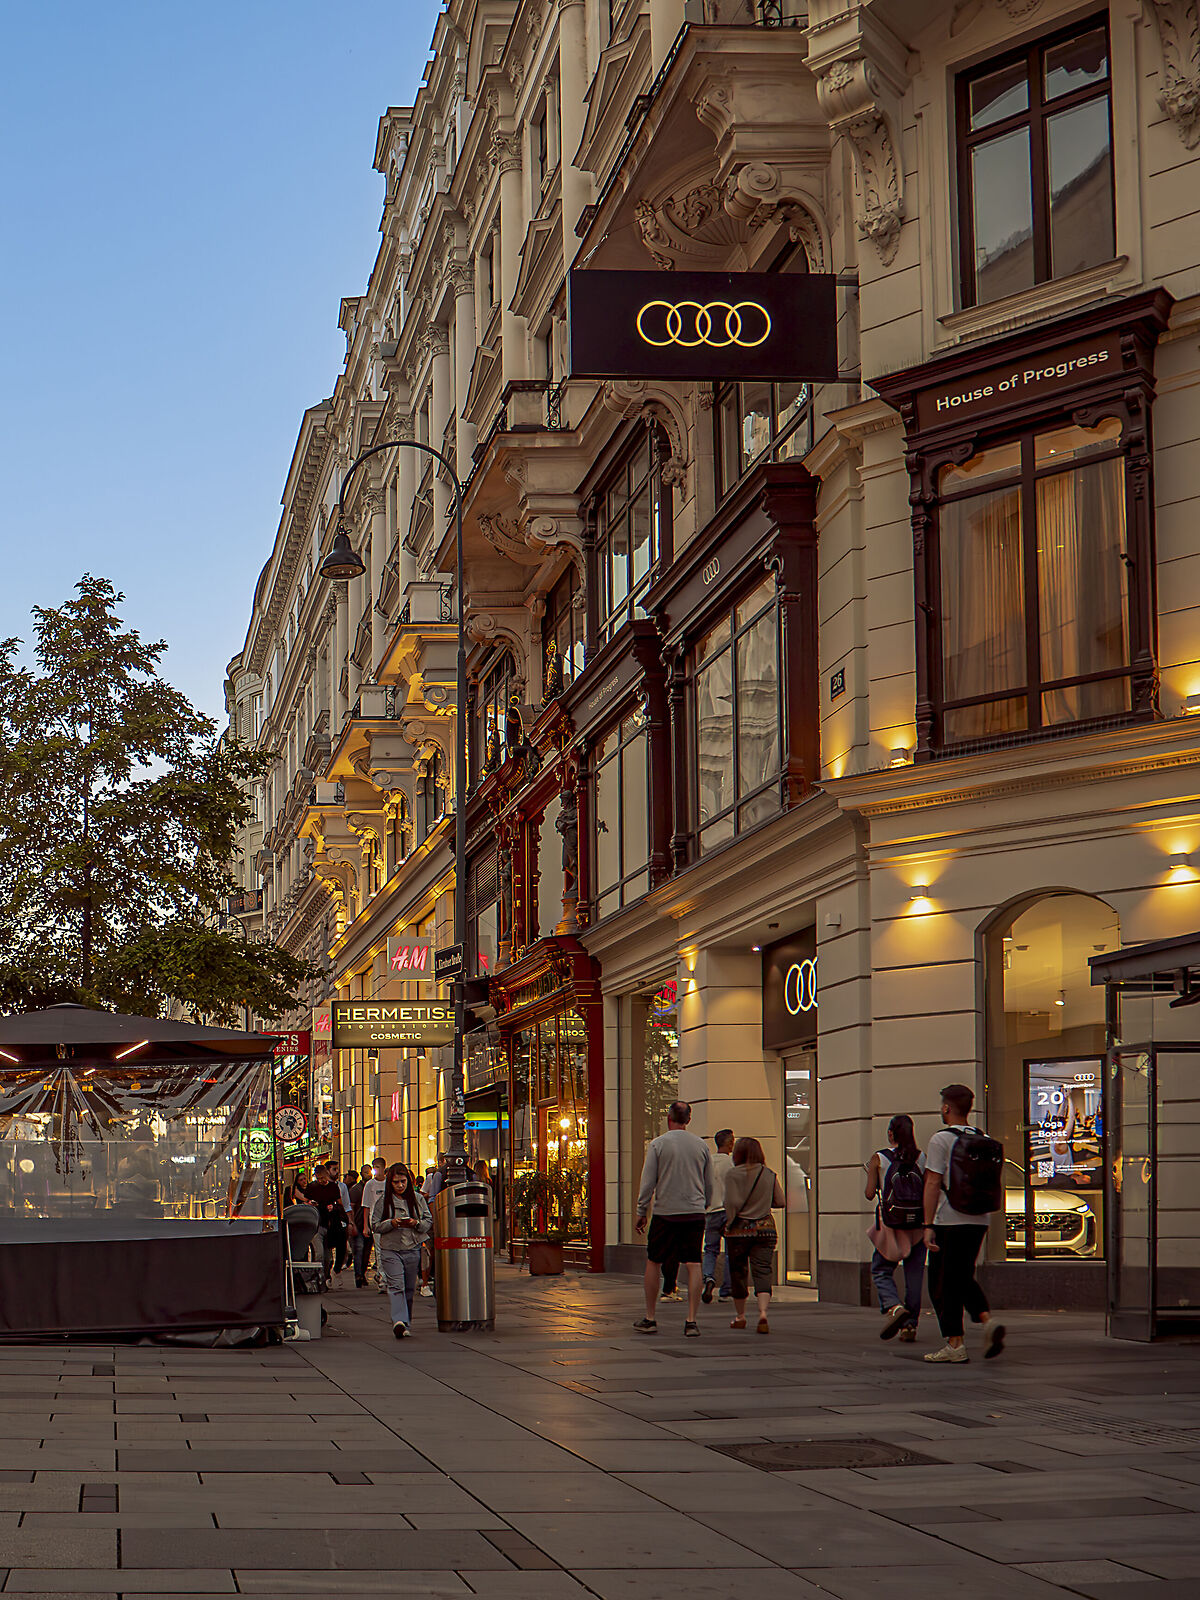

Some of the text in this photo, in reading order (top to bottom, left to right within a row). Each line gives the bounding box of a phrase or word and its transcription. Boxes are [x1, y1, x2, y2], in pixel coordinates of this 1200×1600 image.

[936, 350, 1110, 411] House of Progress
[832, 673, 843, 690] 26
[390, 945, 429, 971] H&M
[1037, 1091, 1064, 1106] 20
[1037, 1121, 1063, 1130] Yoga
